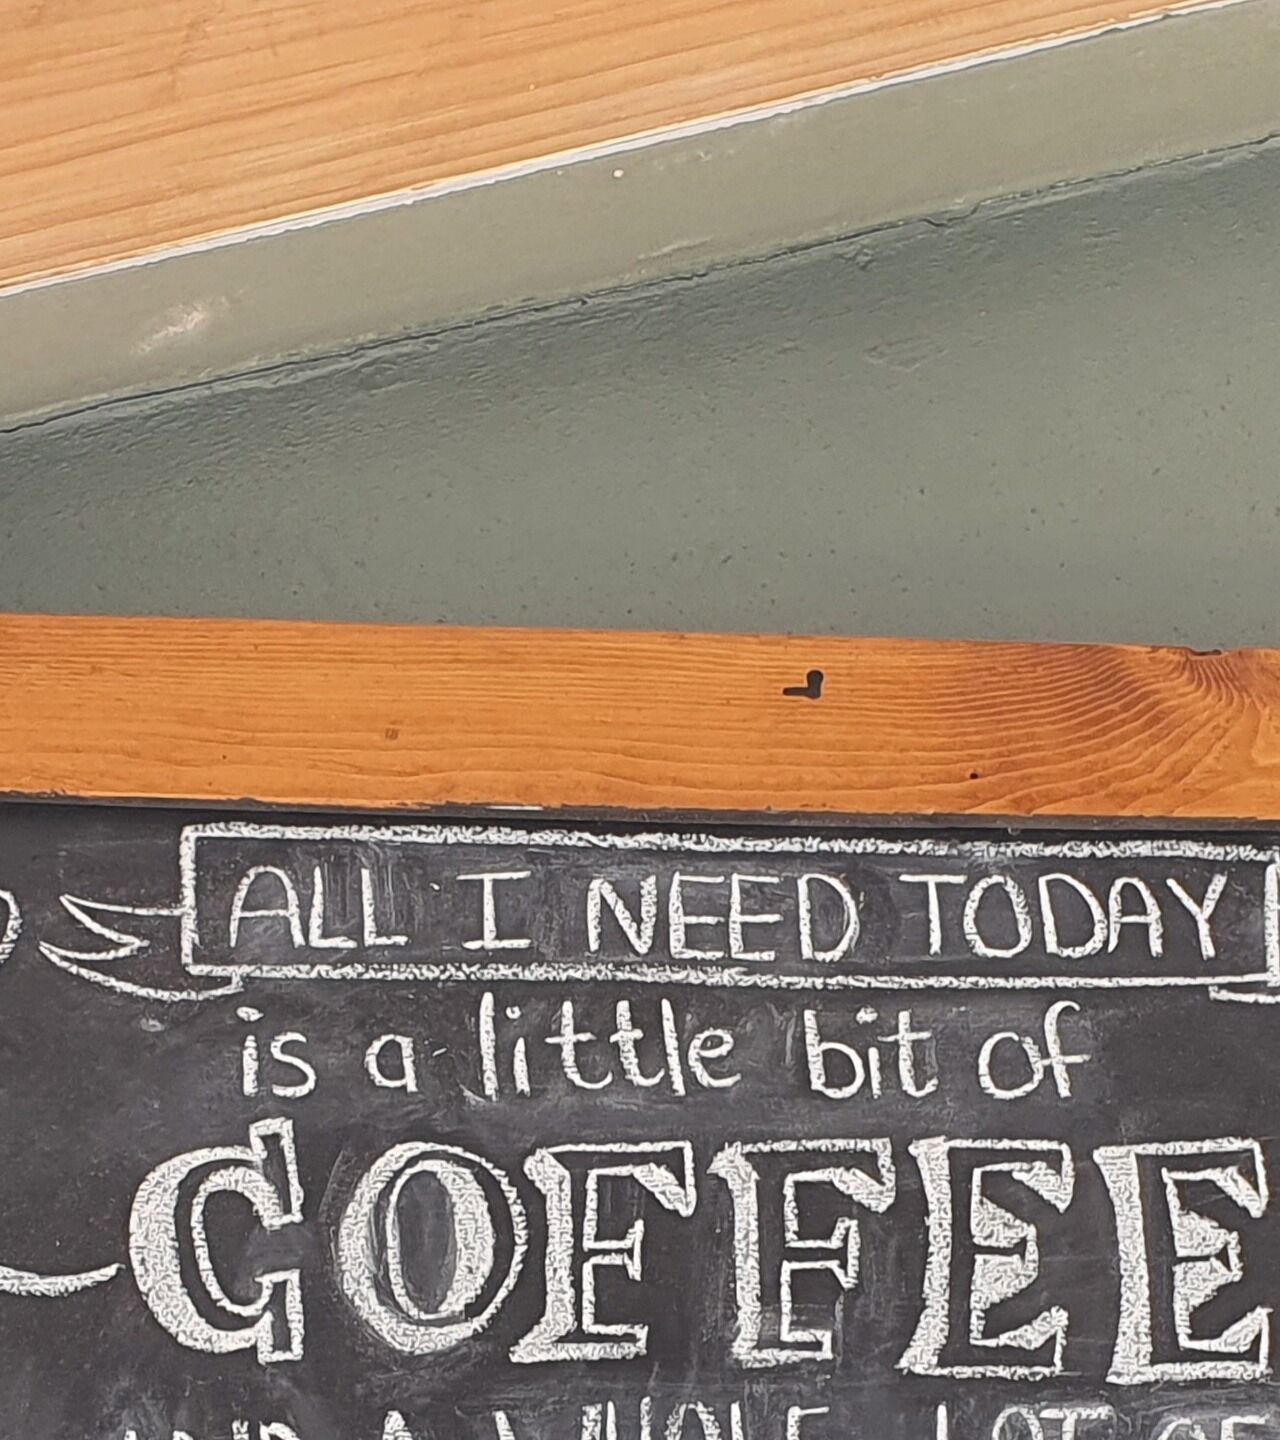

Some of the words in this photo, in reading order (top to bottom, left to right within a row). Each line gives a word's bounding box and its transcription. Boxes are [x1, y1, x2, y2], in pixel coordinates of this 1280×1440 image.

[230, 864, 408, 949] ALL
[456, 869, 532, 950] I
[586, 870, 860, 963] NEED
[899, 872, 1228, 961] TODAY
[235, 1005, 318, 1098] is
[364, 1032, 418, 1093] a
[478, 991, 742, 1099] little
[804, 1008, 939, 1099] bit
[977, 1000, 1091, 1099] of
[128, 1115, 1273, 1385] COFFEE
